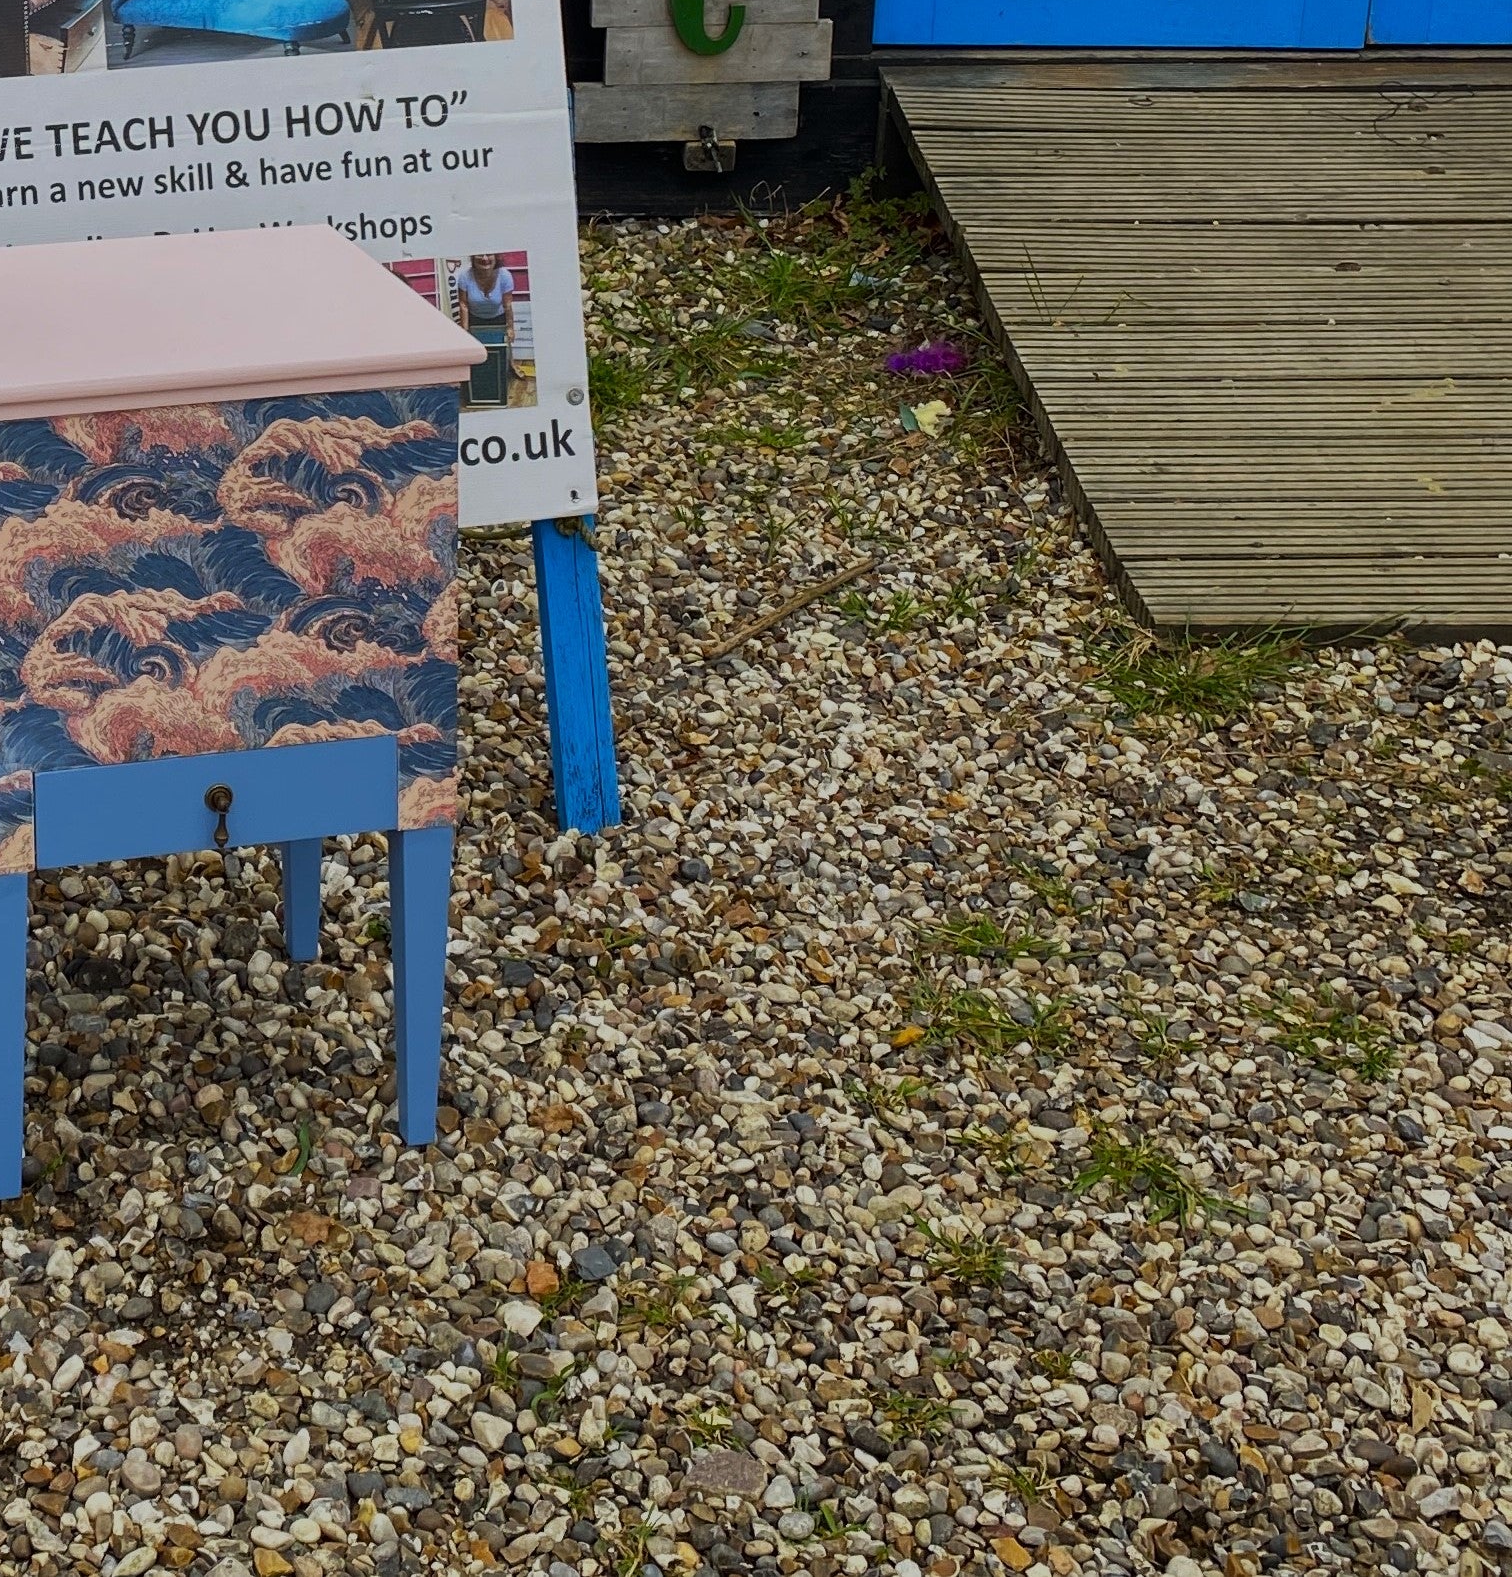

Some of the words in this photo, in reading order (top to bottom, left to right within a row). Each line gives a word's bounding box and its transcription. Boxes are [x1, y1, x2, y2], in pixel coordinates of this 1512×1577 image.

[45, 116, 174, 157] TEACH
[187, 108, 269, 145] YOU
[286, 97, 384, 138] HOW
[51, 183, 66, 203] a
[78, 176, 143, 200] new
[155, 163, 213, 194] skill
[226, 161, 249, 188] &
[260, 158, 331, 185] have
[341, 151, 391, 178] fun
[404, 149, 432, 173] at
[443, 148, 493, 170] our
[459, 418, 577, 467] co.uk
